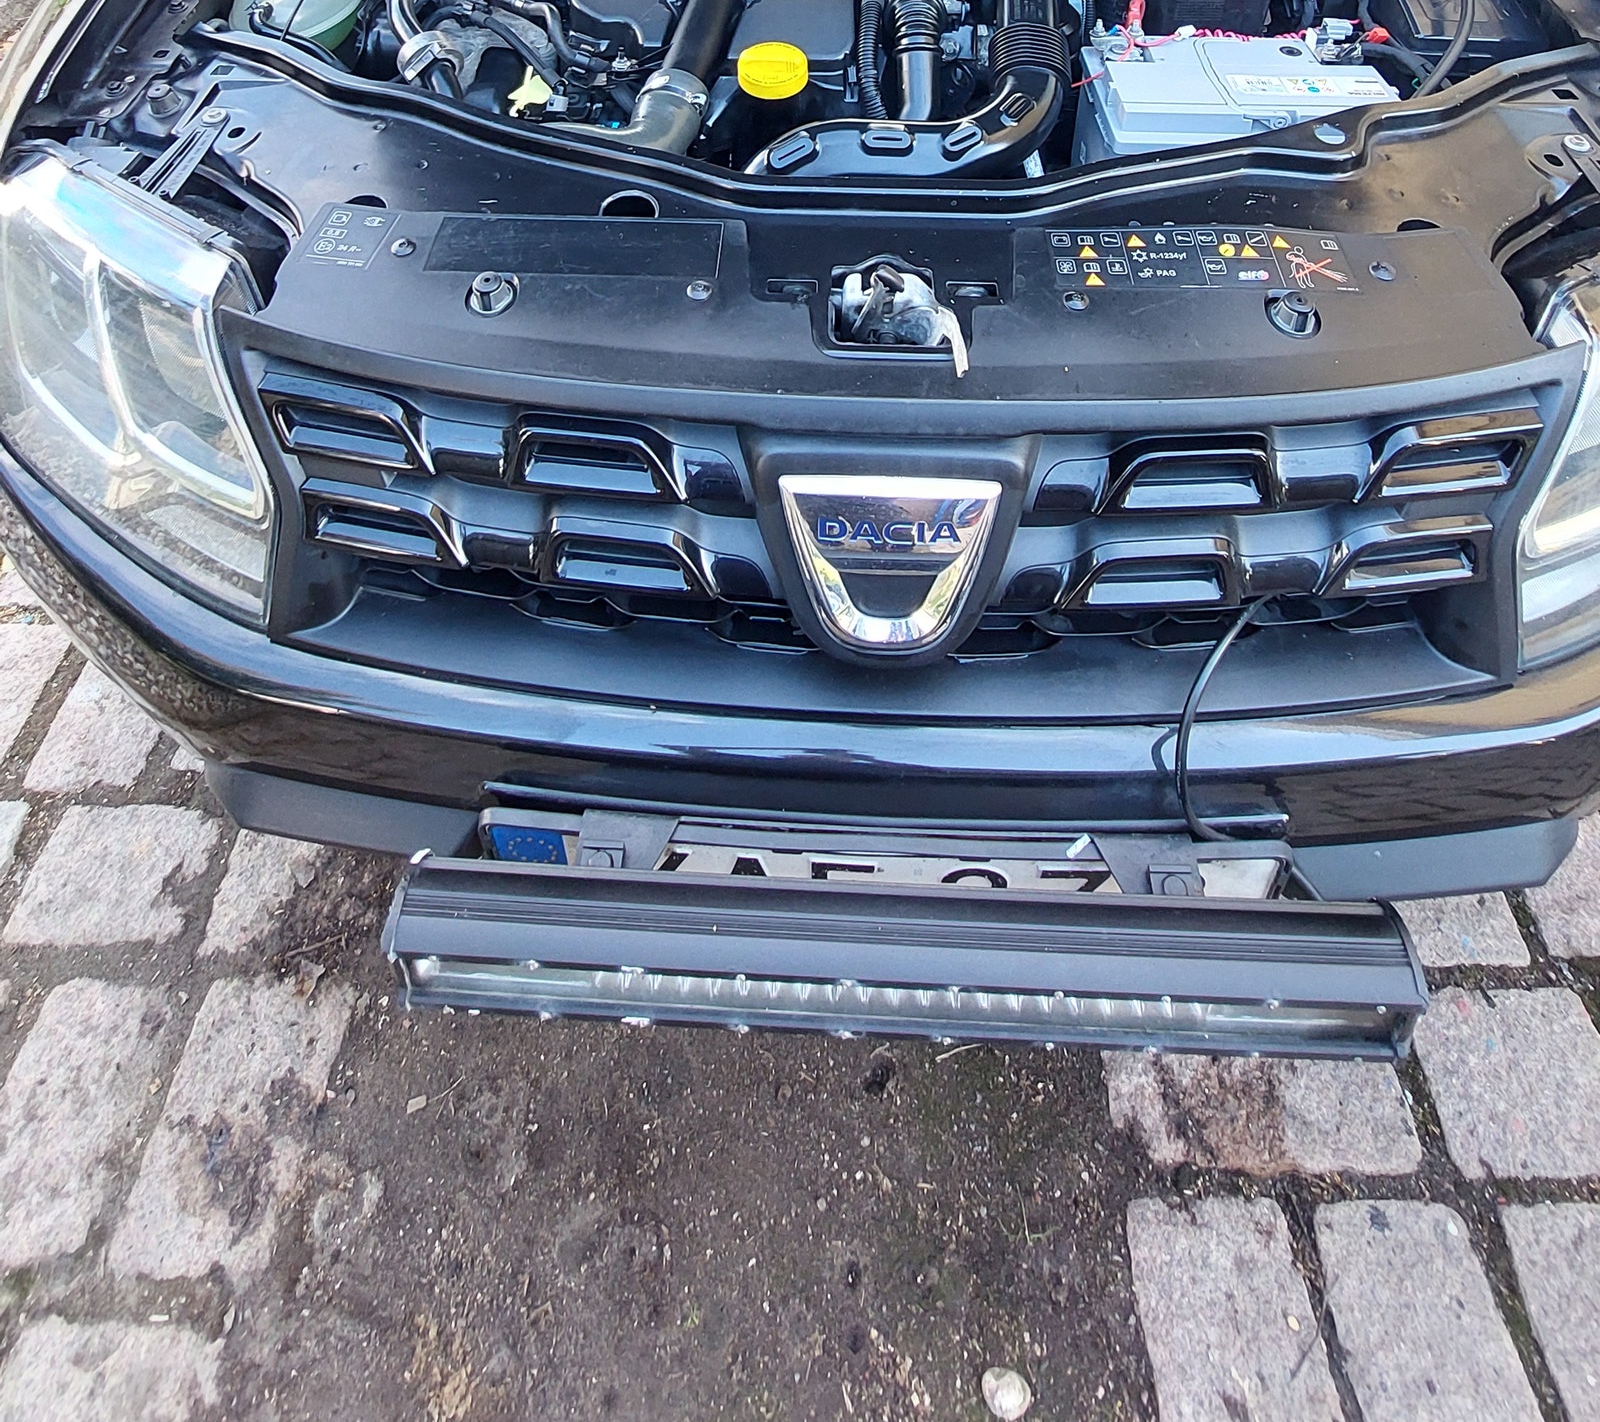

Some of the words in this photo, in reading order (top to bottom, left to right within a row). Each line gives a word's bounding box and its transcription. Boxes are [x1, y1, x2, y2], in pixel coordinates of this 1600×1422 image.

[1150, 252, 1187, 261] R-1234yf
[1156, 268, 1177, 277] PAG
[817, 517, 961, 545] DACIA
